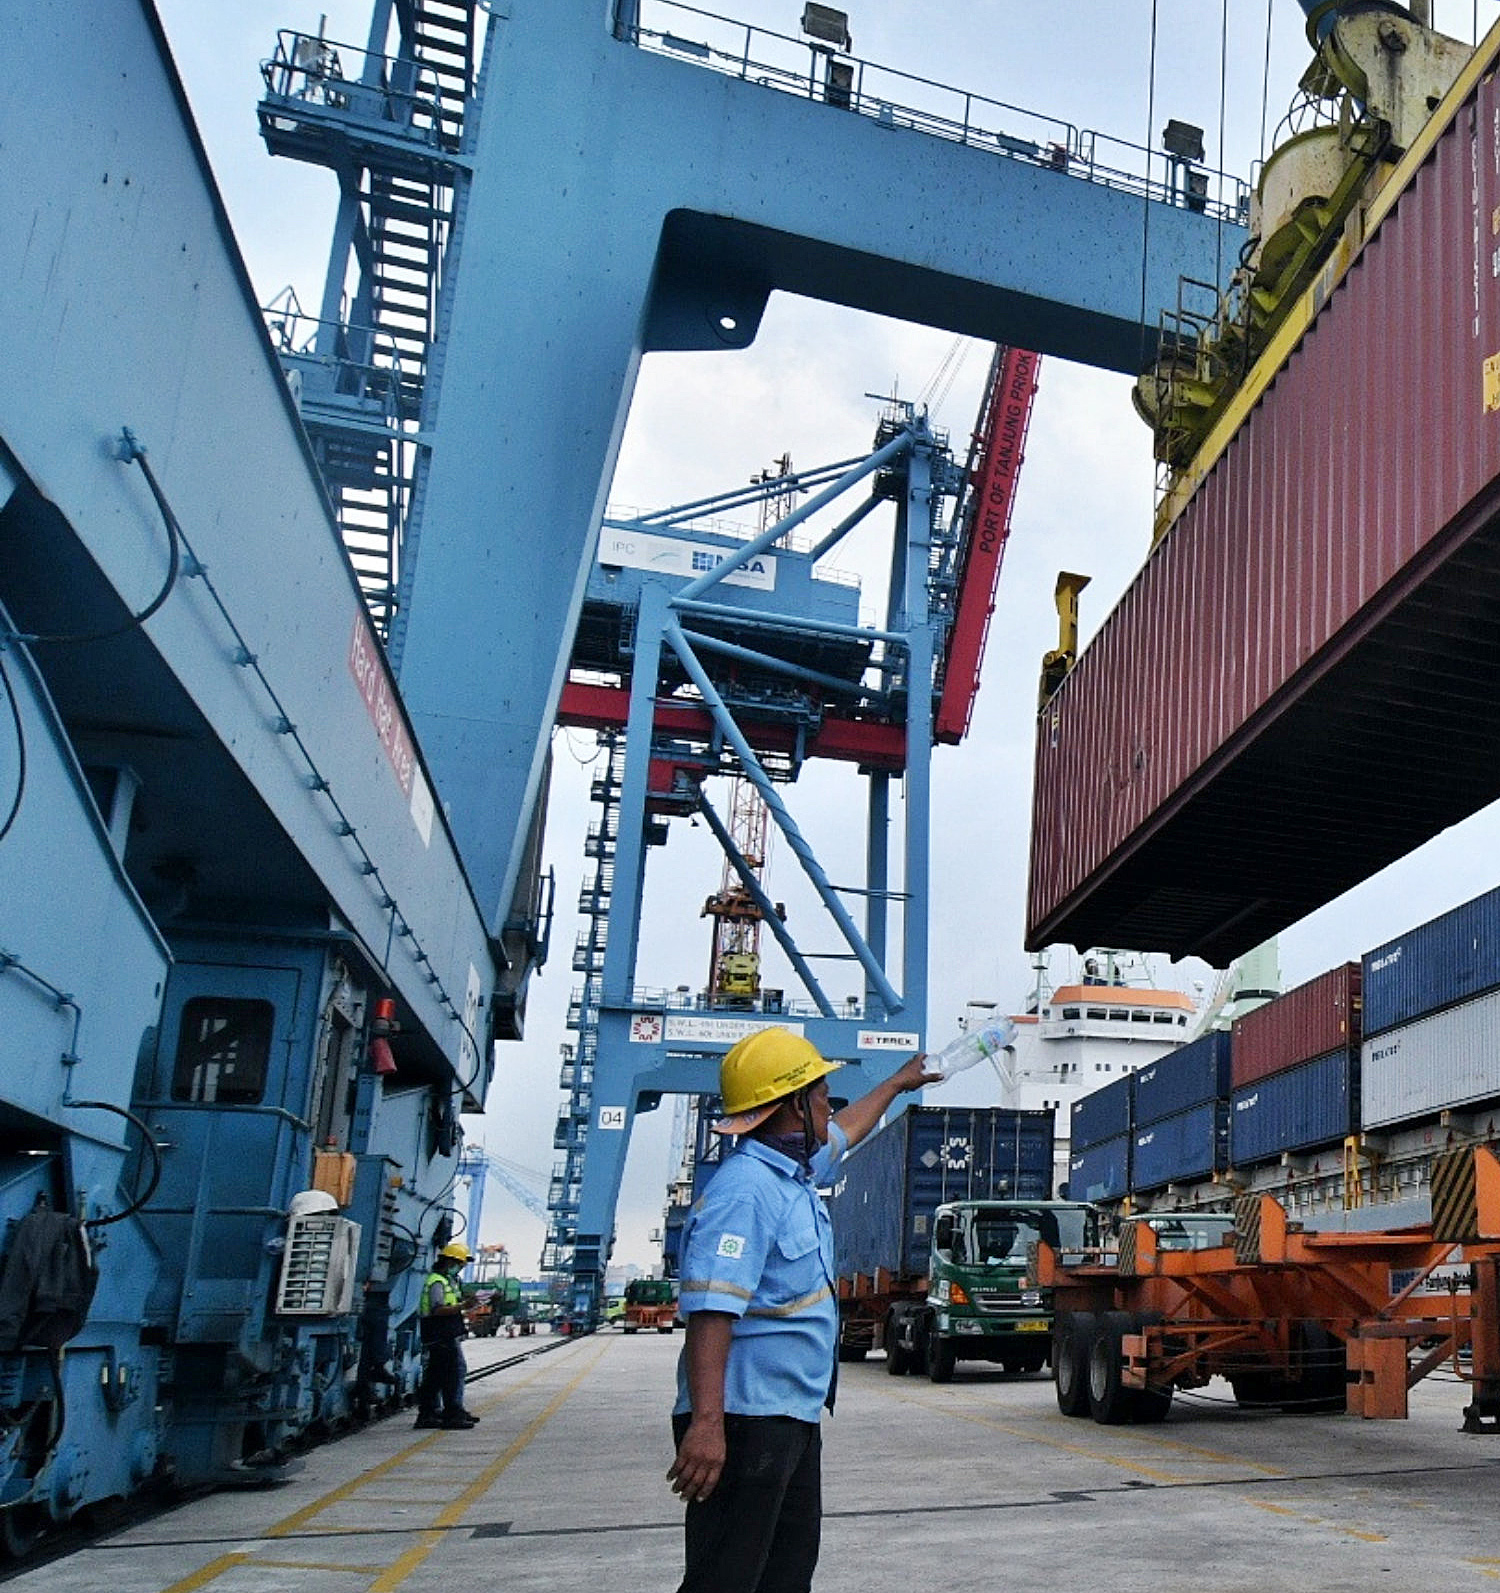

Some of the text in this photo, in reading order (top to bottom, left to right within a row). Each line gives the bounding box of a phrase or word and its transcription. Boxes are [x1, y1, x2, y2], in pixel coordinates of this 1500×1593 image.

[980, 353, 1033, 553] PORT OF TANJUNG PRIOK
[612, 541, 636, 555] IPC
[601, 1110, 623, 1126] 04
